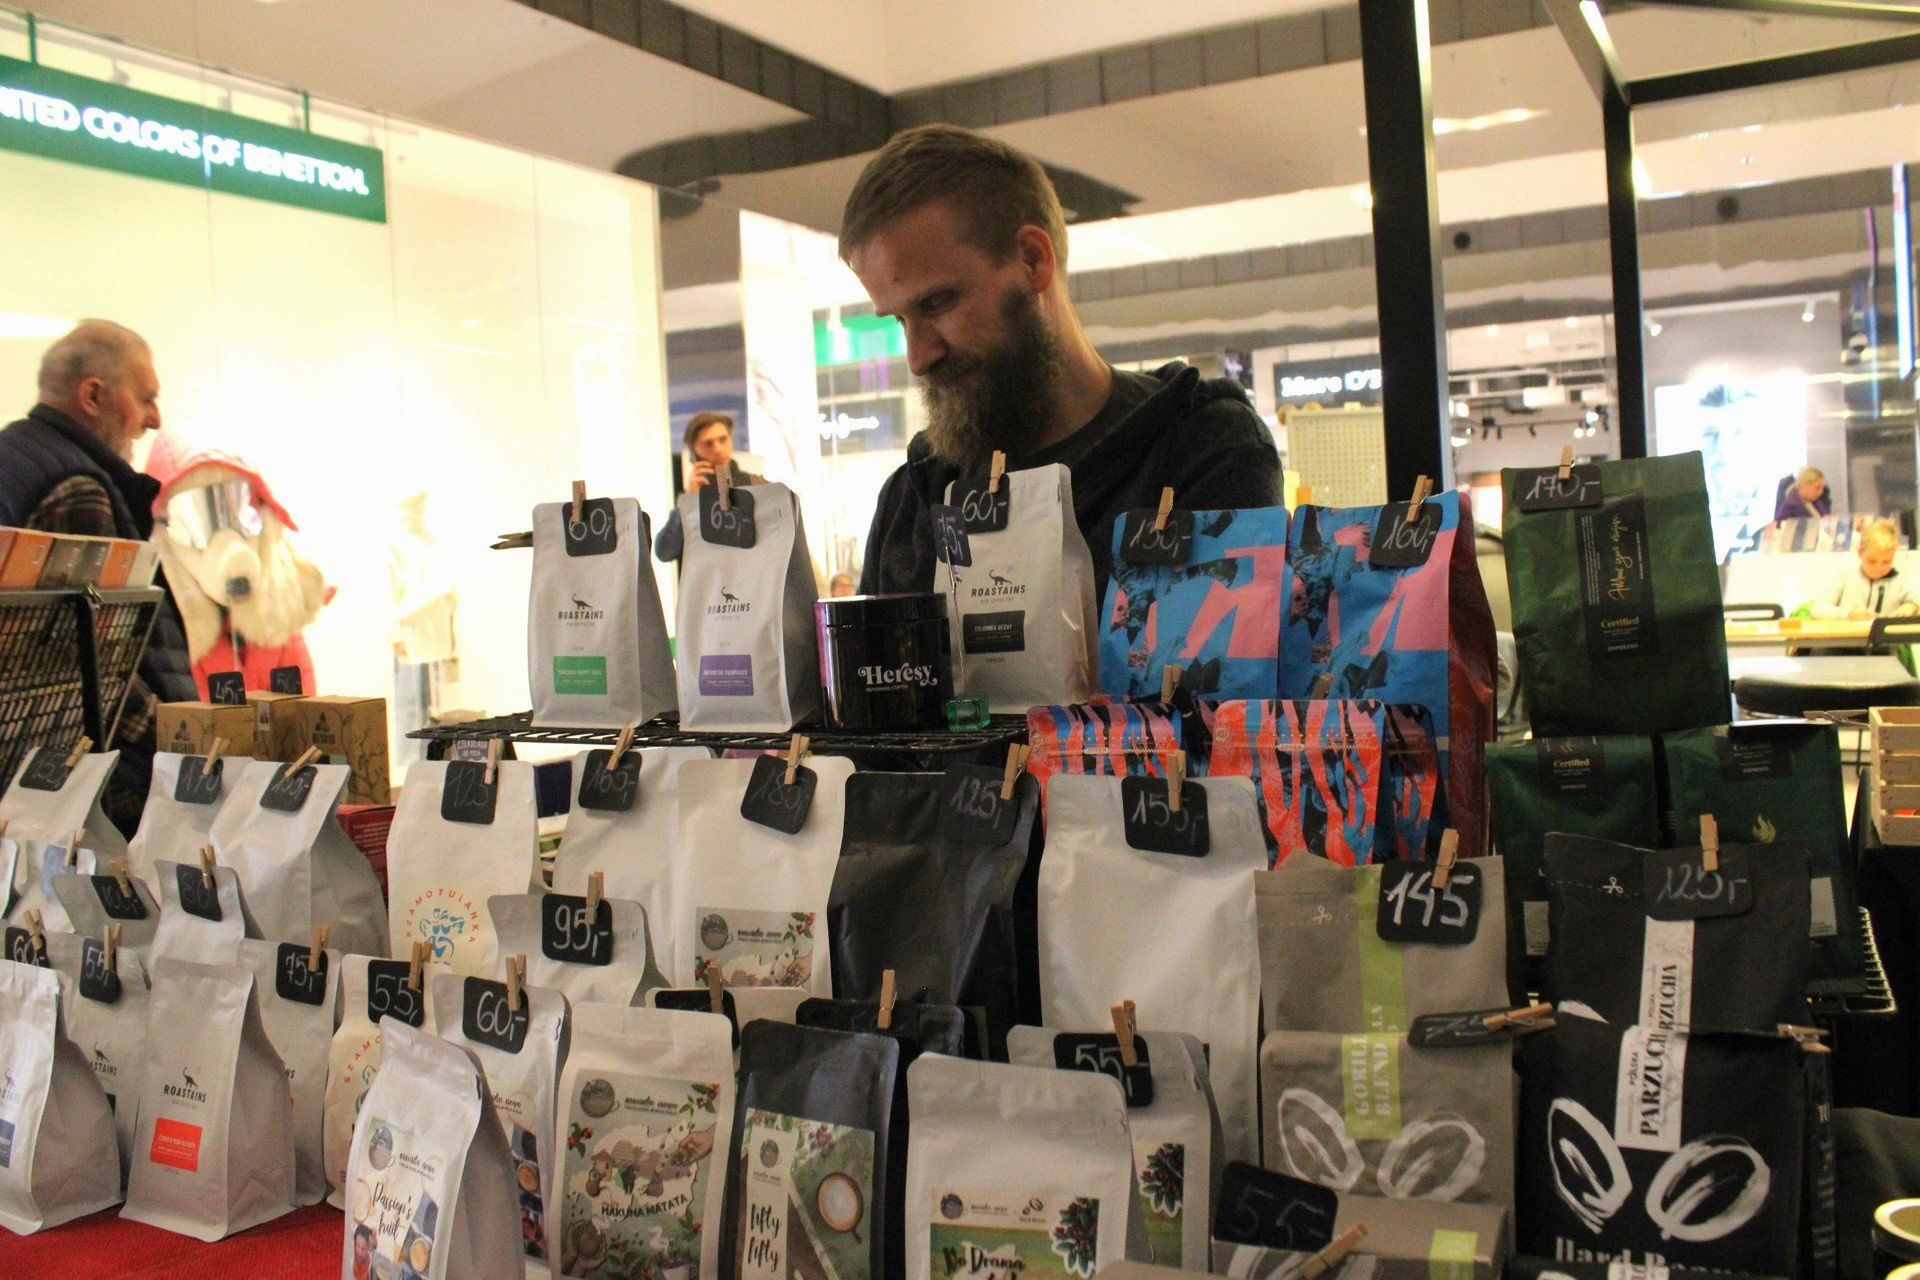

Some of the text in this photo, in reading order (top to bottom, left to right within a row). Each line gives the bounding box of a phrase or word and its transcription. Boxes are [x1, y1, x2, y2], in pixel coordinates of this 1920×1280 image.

[82, 106, 201, 159] COLORS
[203, 134, 240, 167] OF
[961, 489, 1007, 523] 60,-
[971, 584, 1026, 597] ROASTAINS
[558, 609, 604, 621] ROASTAINS
[707, 602, 751, 615] ROASTAINS
[1601, 616, 1640, 629] Certified
[857, 662, 938, 687] Heresy
[1553, 758, 1591, 768] Certified
[1384, 871, 1475, 928] 145
[405, 887, 480, 944] SZAMOTULANKA
[552, 904, 610, 958] 95,-
[476, 990, 526, 1041] 60,-
[163, 1084, 207, 1104] ROASTAINS
[373, 1180, 414, 1221] Passion's
[602, 1194, 689, 1218] HAKUNA MATATA
